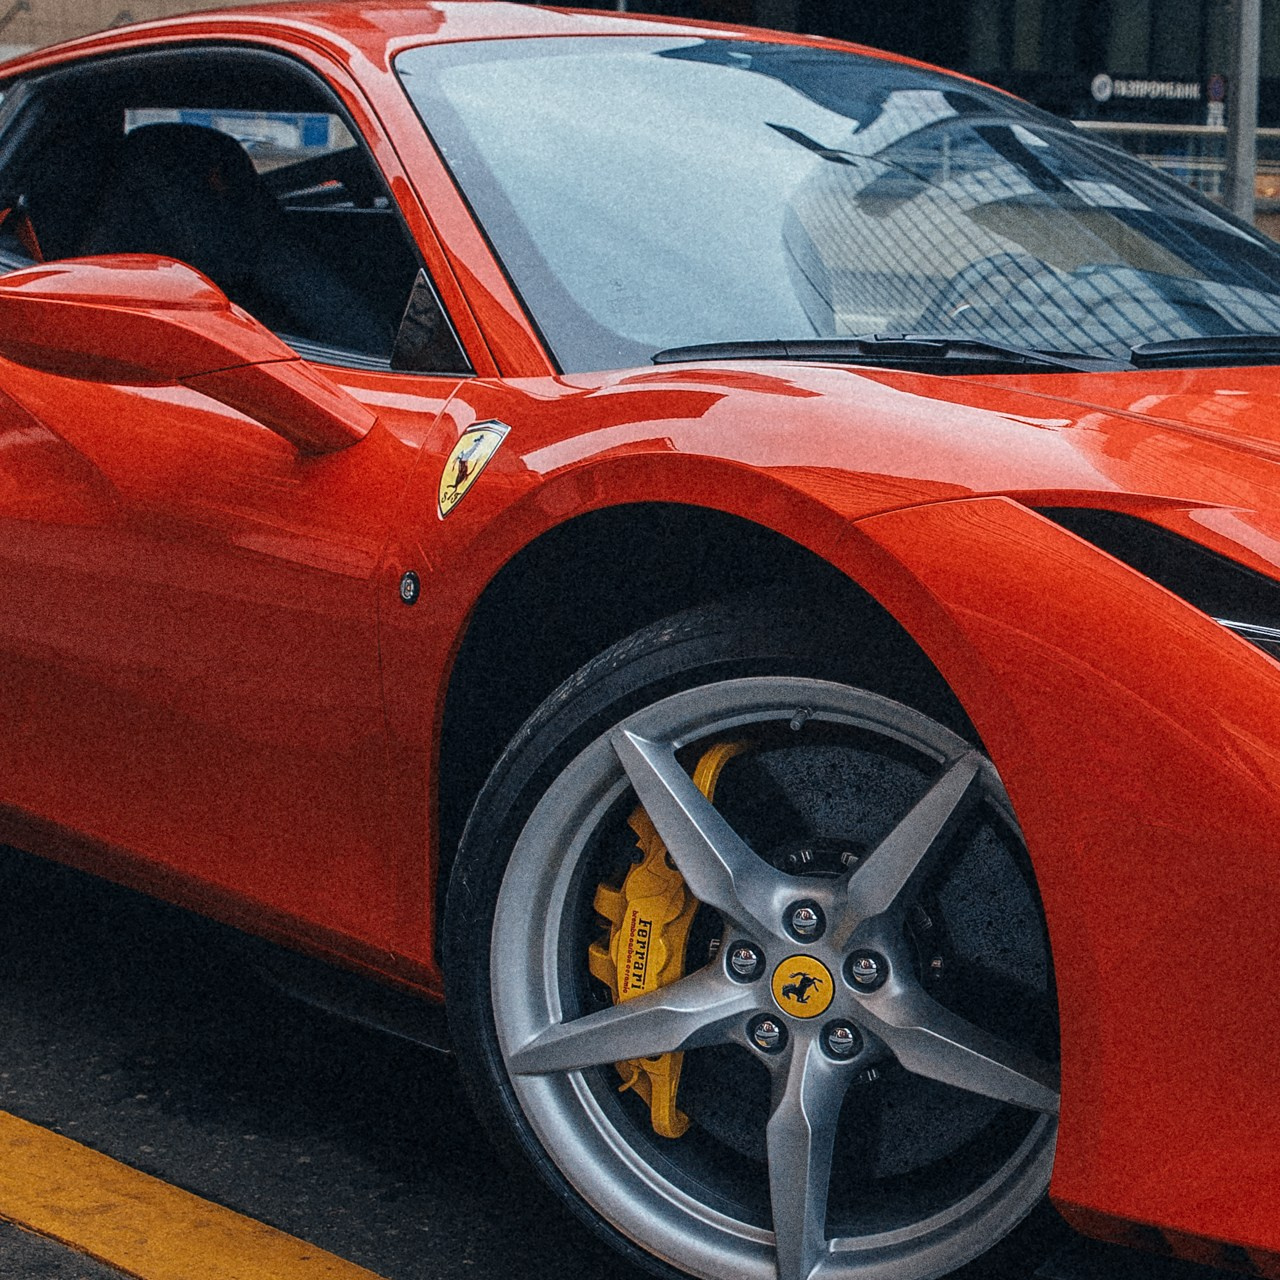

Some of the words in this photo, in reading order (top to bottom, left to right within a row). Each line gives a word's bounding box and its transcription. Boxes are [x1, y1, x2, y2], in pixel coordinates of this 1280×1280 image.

[630, 910, 638, 937] brembo
[631, 918, 652, 990] Ferrari
[623, 964, 631, 993] ceramic
